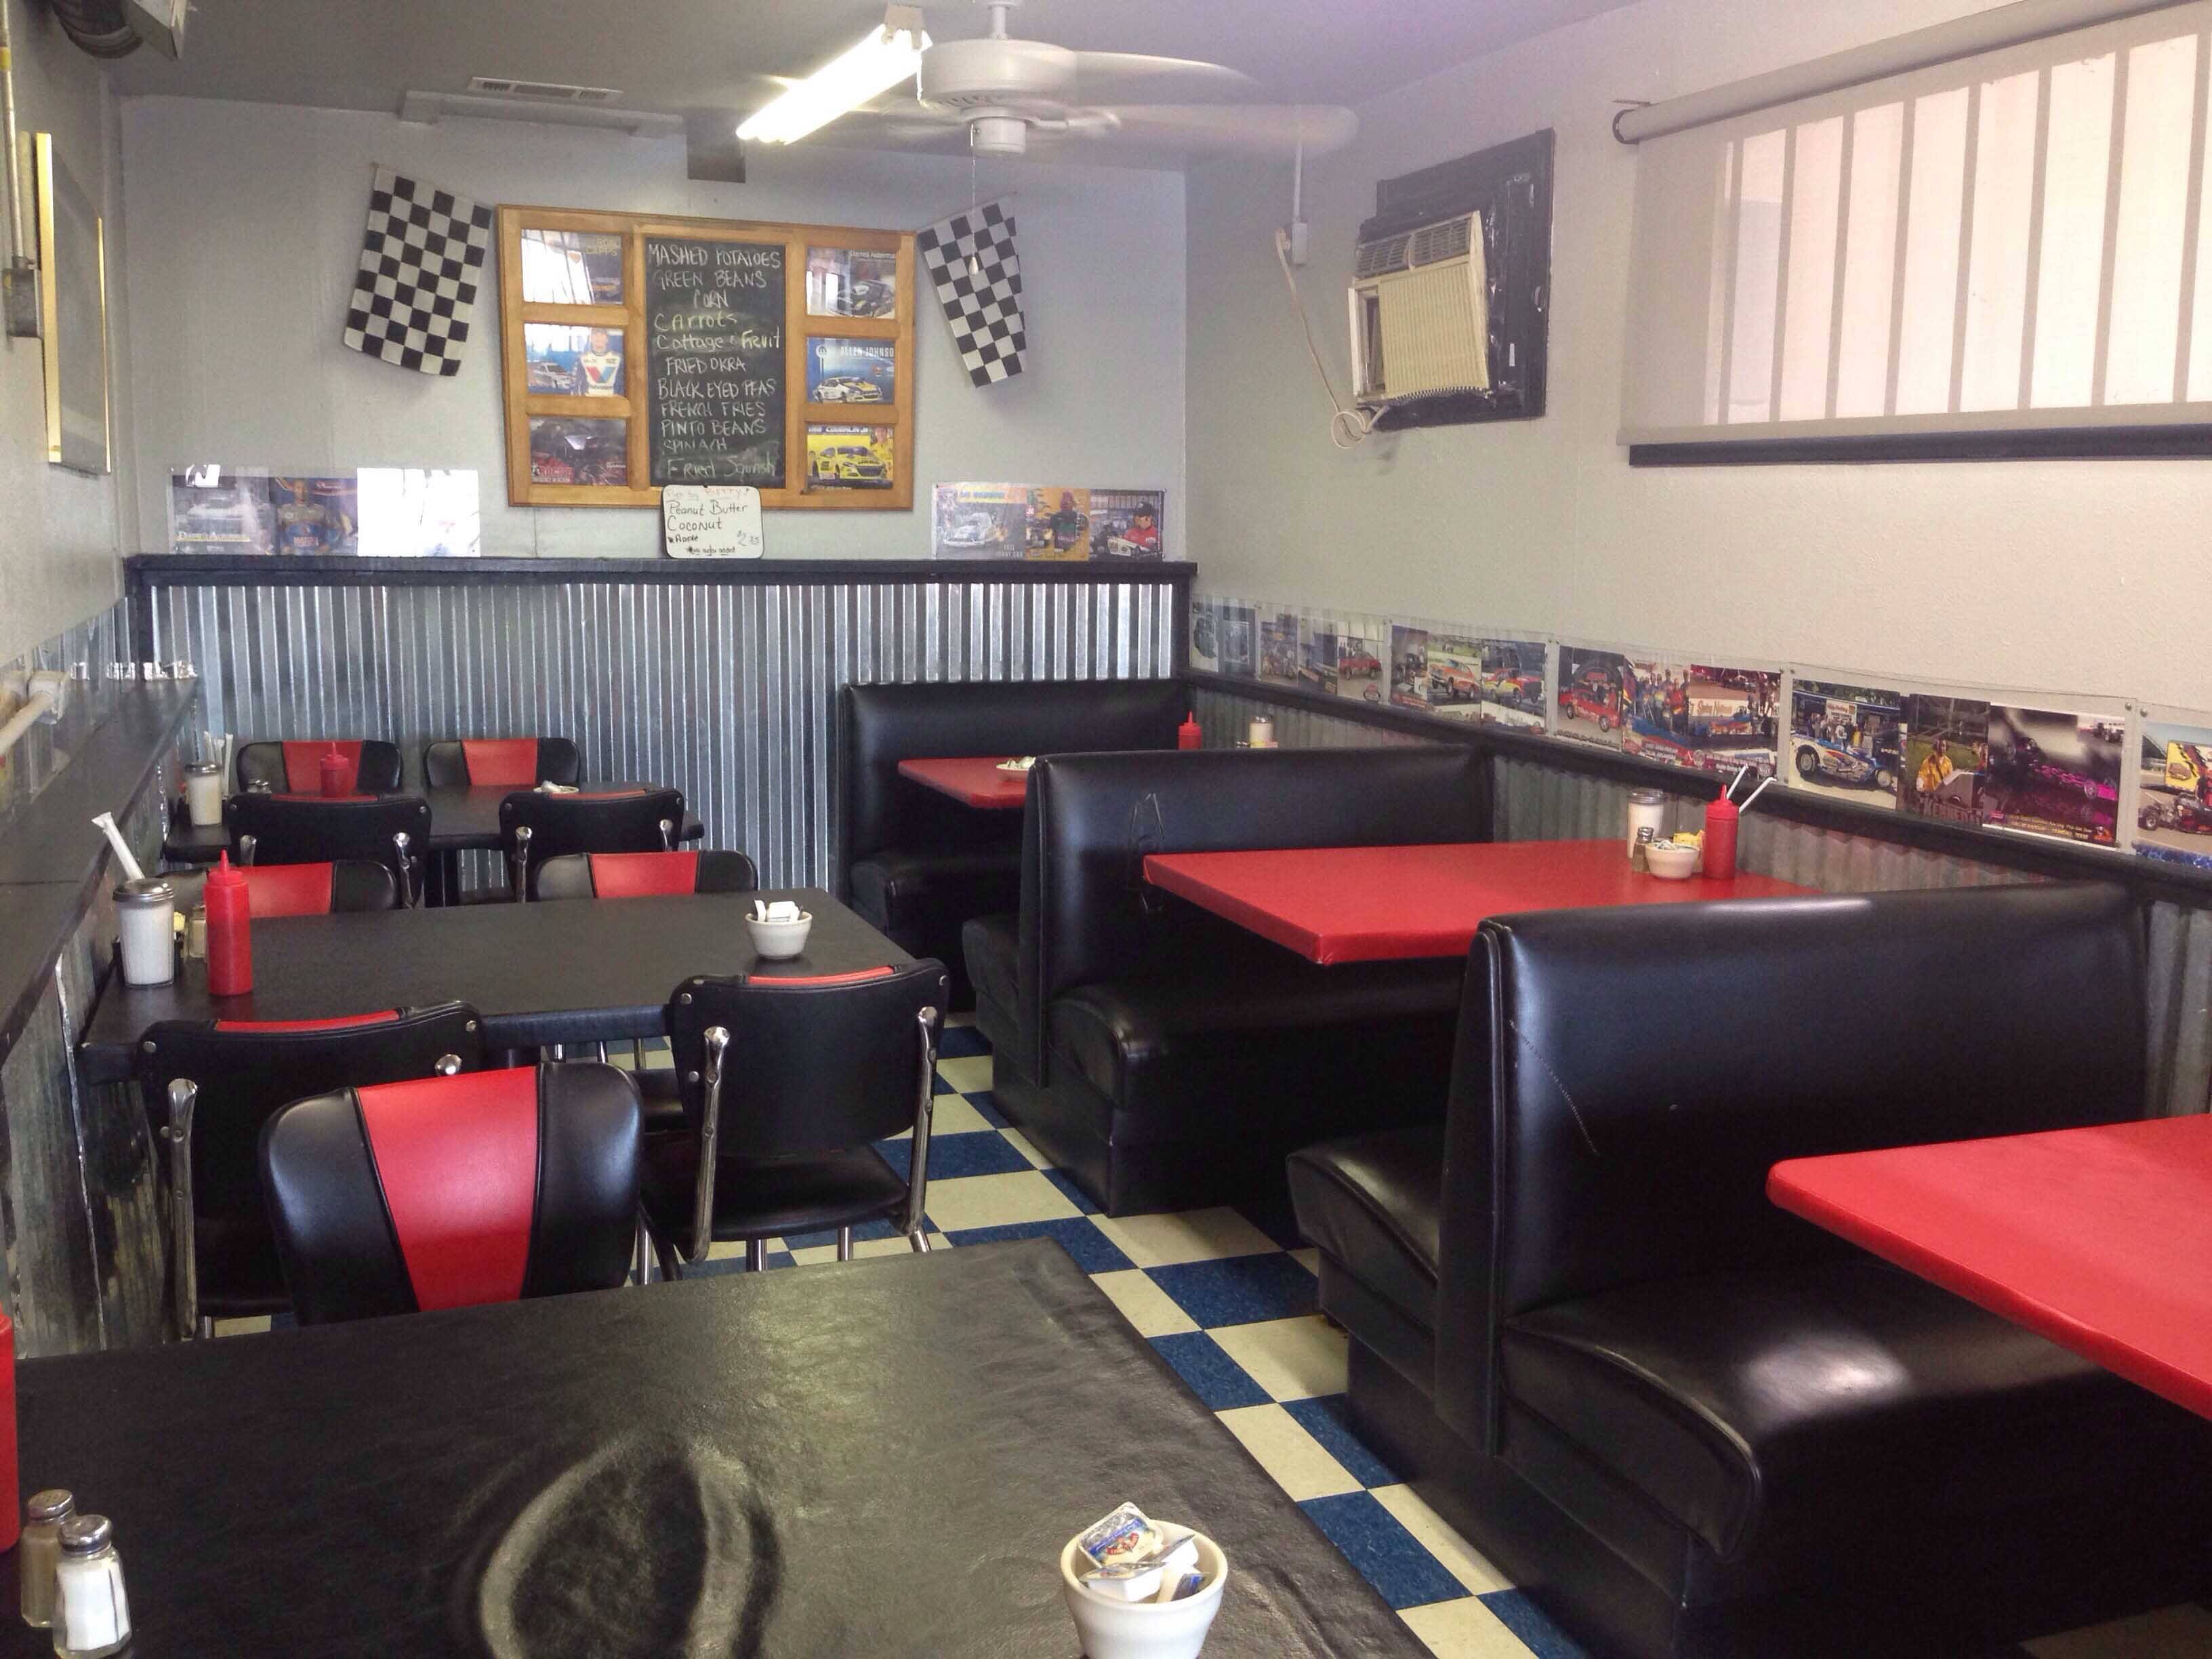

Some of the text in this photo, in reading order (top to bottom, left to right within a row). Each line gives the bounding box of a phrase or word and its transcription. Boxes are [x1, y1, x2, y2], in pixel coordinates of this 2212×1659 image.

[648, 243, 781, 268] MASHED POTATOES
[653, 269, 767, 290] GREEN BEANS
[693, 289, 729, 308] CORN
[656, 334, 724, 352] Cottage
[840, 346, 863, 356] ALLEN
[665, 356, 746, 375] FRIED OKRA
[657, 377, 777, 400] BLACK EYED PEAS
[661, 401, 766, 417] FRENCH FRIES
[661, 418, 766, 437] PINTO BEANS
[663, 437, 728, 453] SPINACH
[667, 499, 749, 516] Peanut Butter
